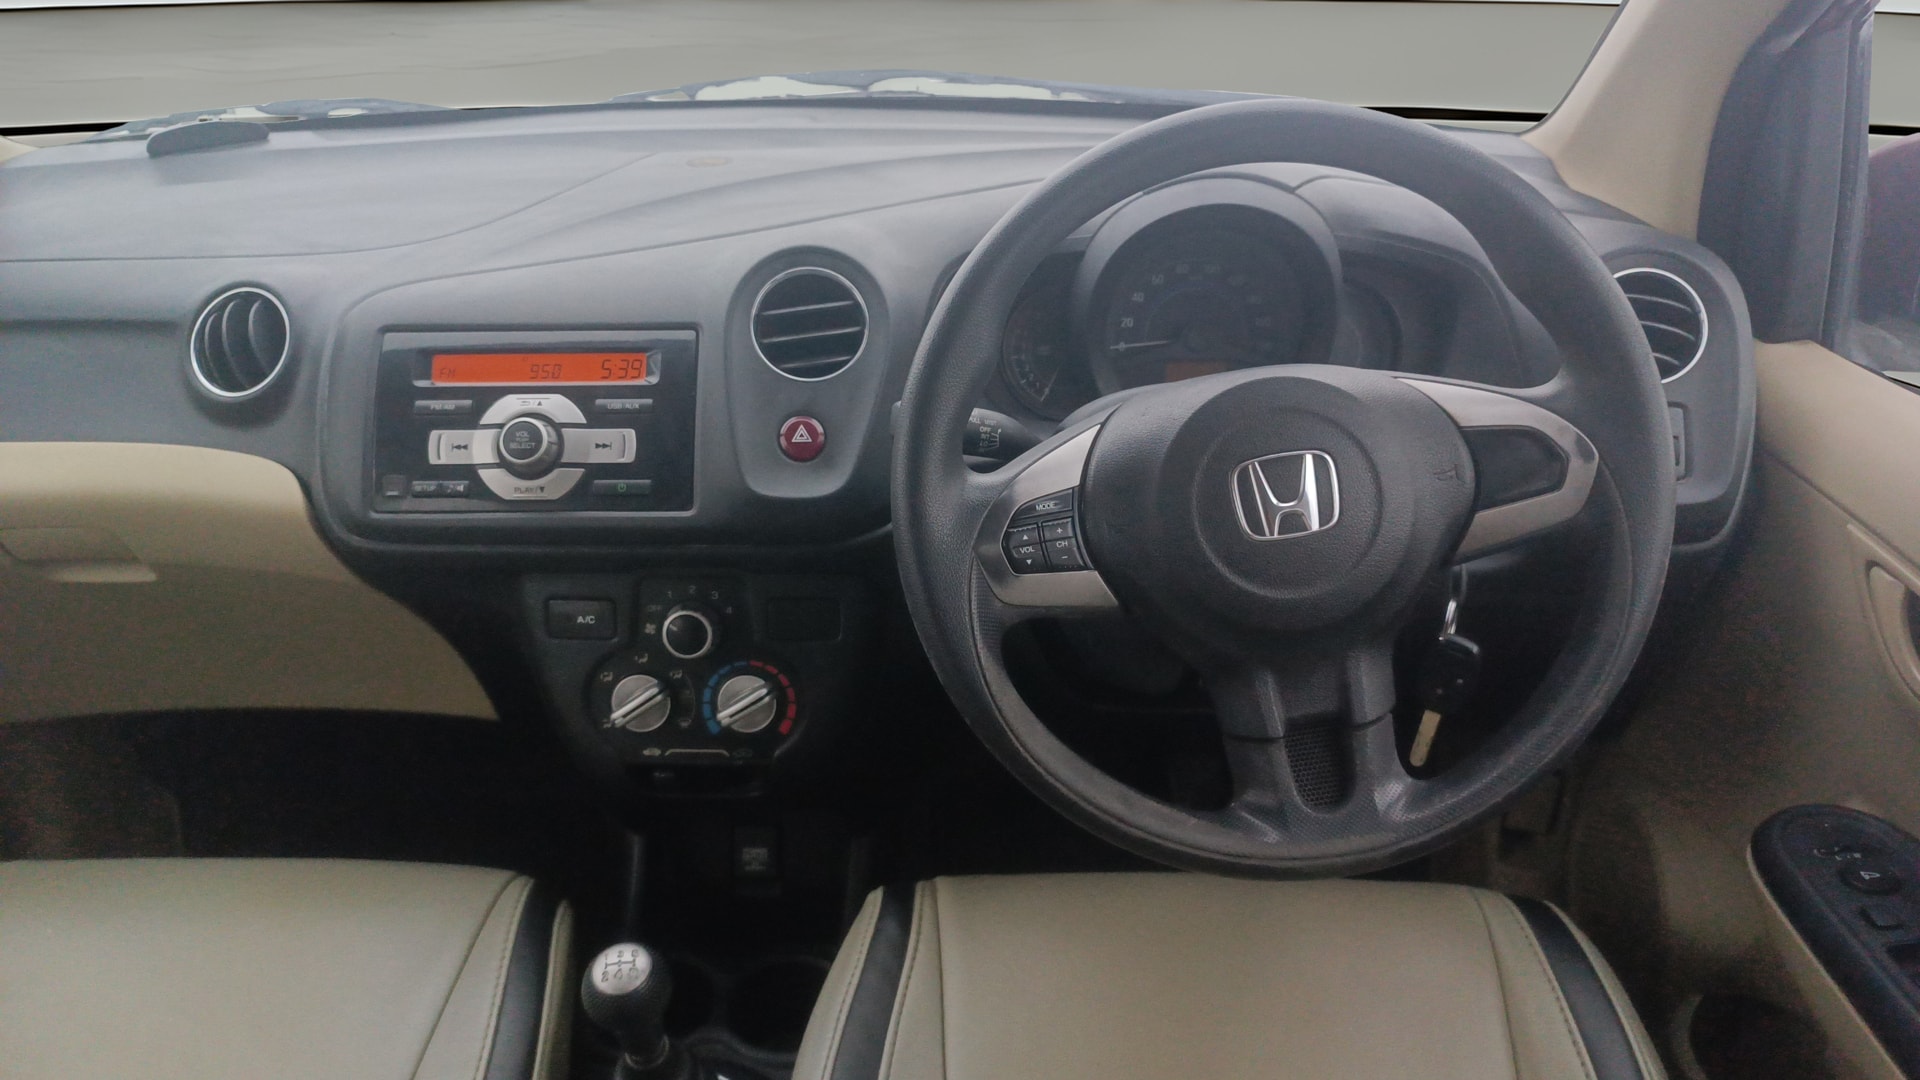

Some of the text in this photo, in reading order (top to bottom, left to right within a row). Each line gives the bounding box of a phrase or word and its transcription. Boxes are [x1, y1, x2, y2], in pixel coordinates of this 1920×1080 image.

[1120, 317, 1134, 328] 20
[600, 358, 643, 380] 5:39
[515, 430, 530, 438] VOL
[979, 426, 992, 434] OFF
[1035, 501, 1057, 512] MODE
[1019, 545, 1035, 554] VOL
[1056, 540, 1068, 549] CH
[711, 590, 719, 600] 3
[576, 615, 596, 625] A/C
